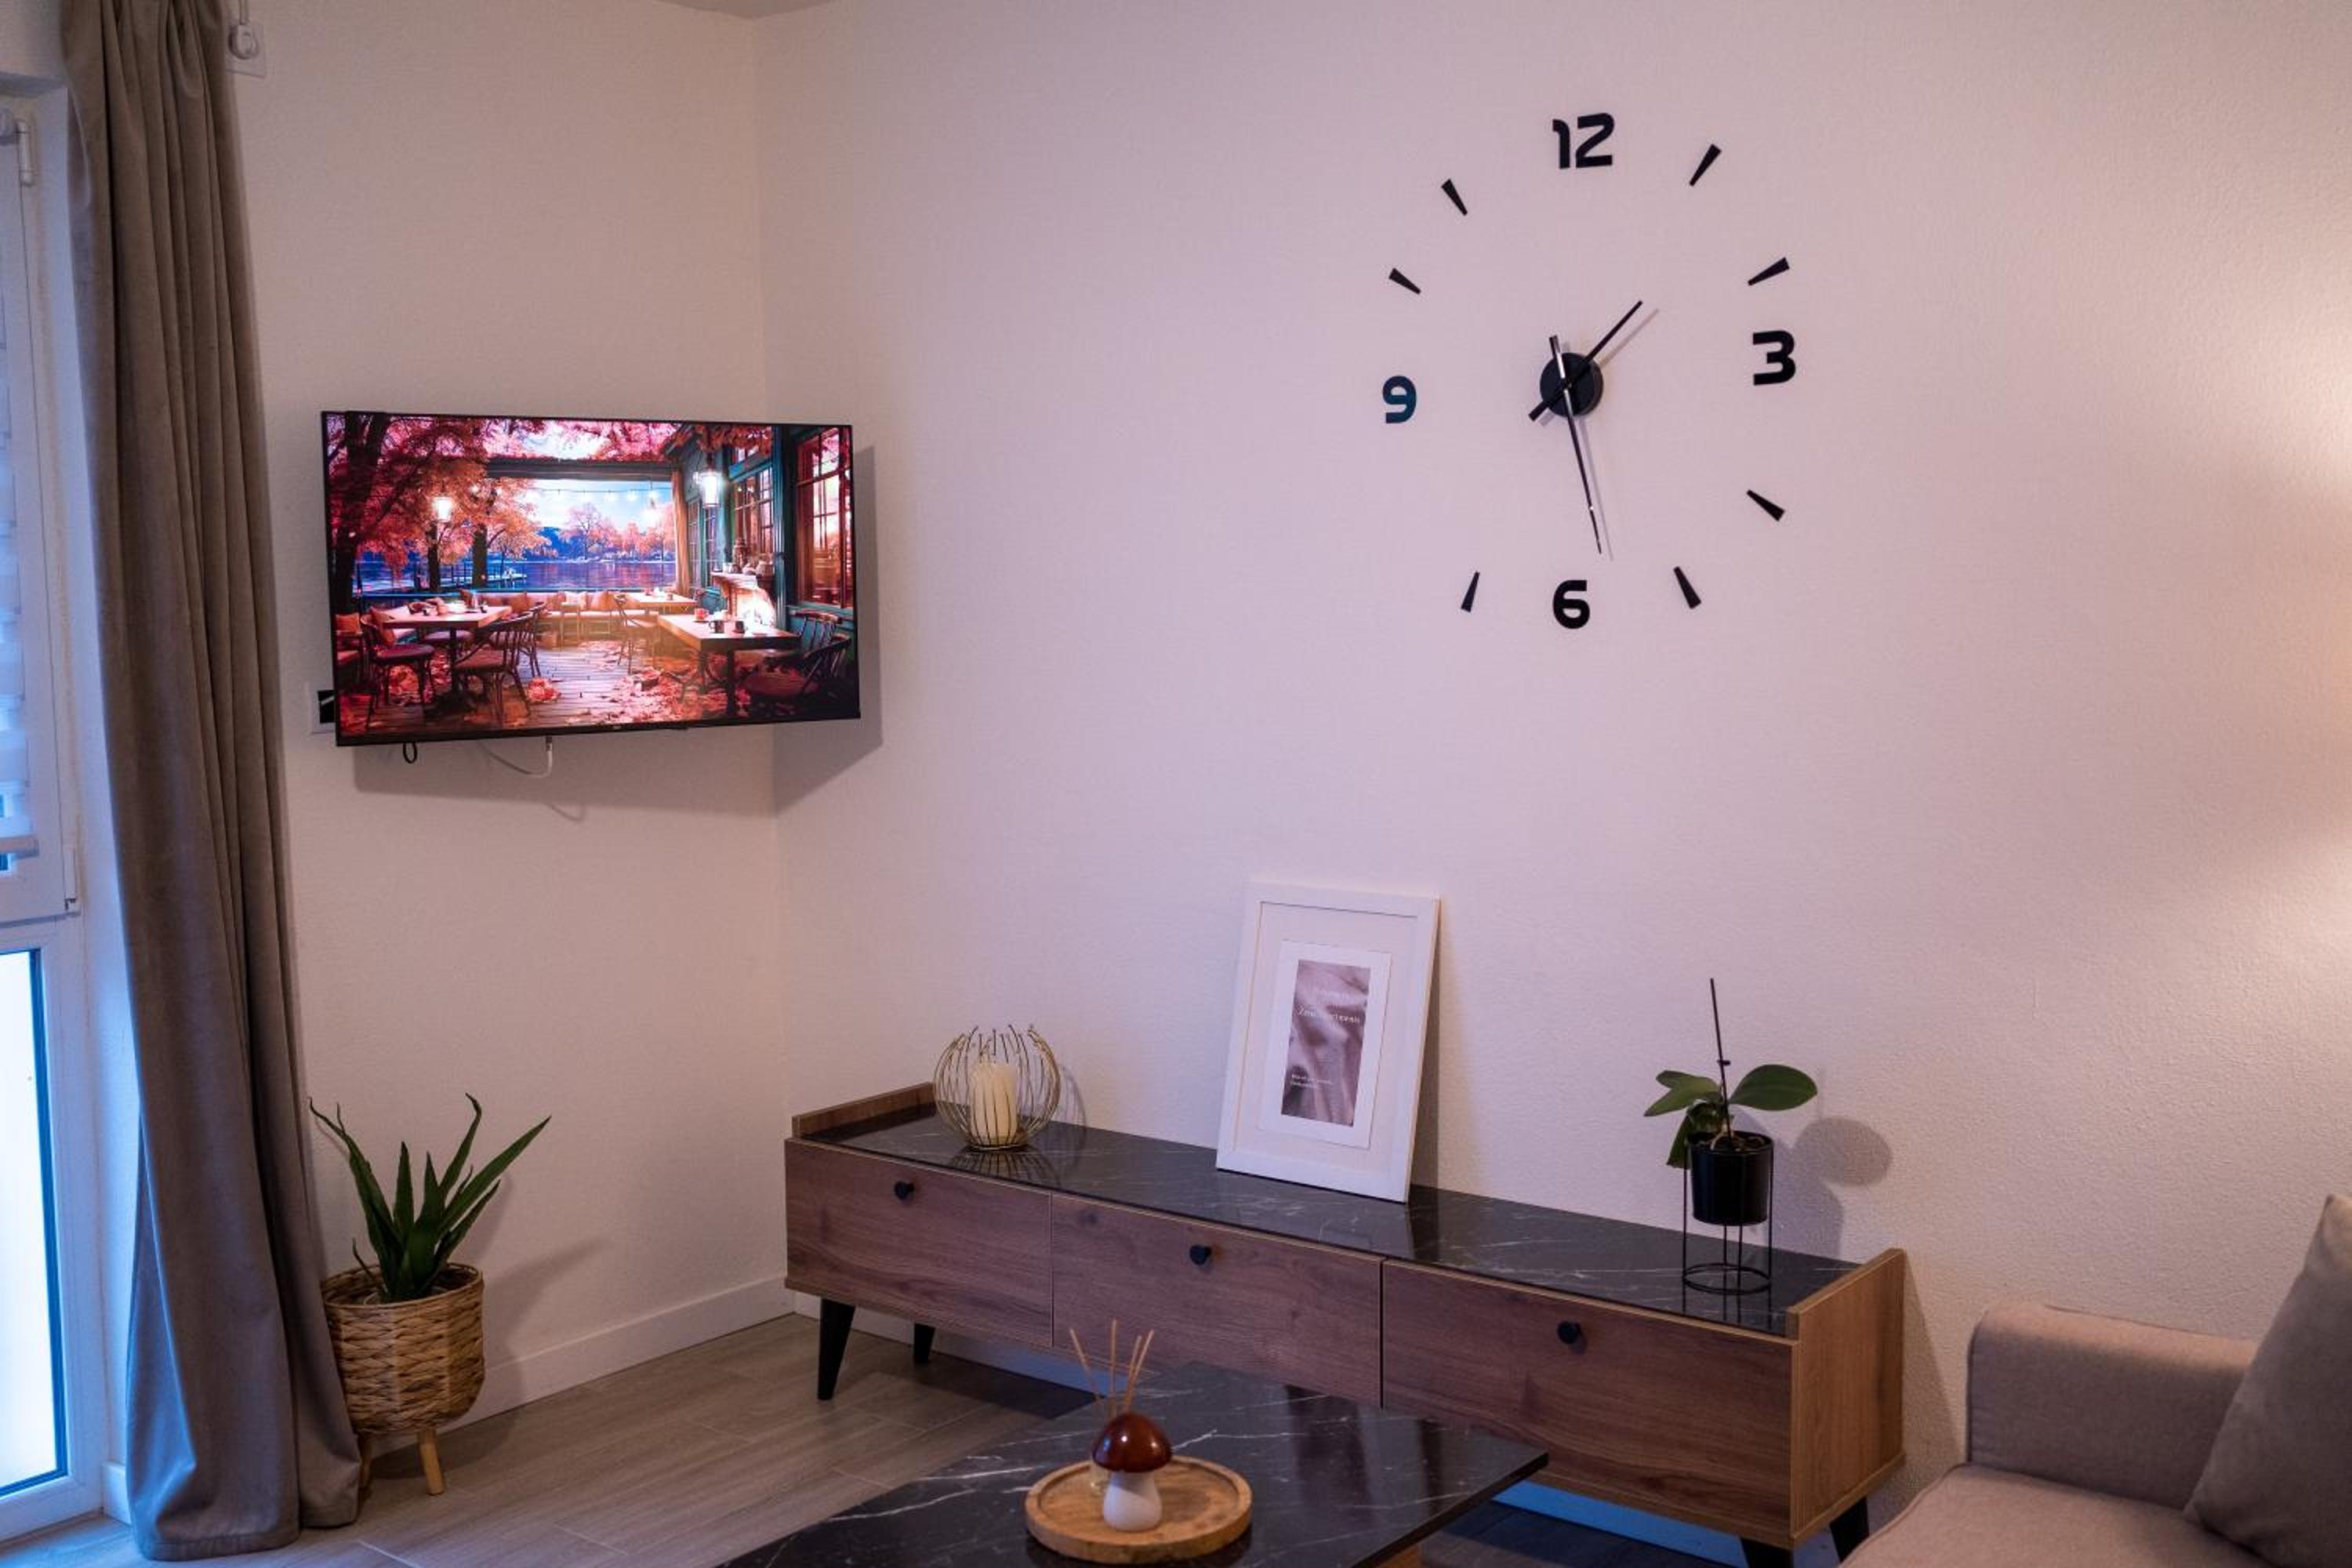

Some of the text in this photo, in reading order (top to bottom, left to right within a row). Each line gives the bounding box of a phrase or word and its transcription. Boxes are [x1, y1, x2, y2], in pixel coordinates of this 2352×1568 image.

[1552, 112, 1614, 169] 12
[1752, 330, 1795, 386] 3
[1382, 376, 1417, 423] 9
[1552, 579, 1590, 629] 6
